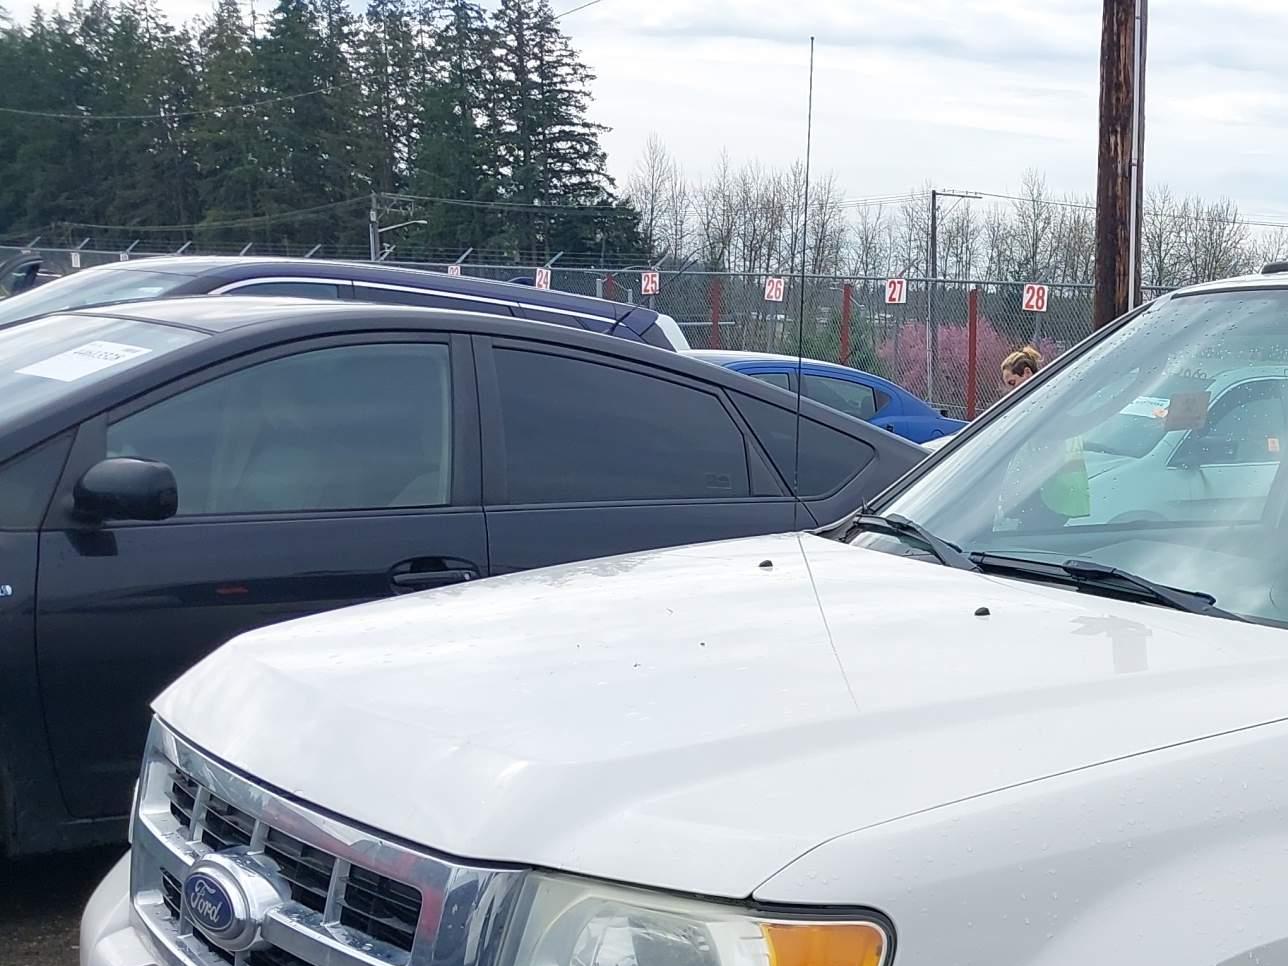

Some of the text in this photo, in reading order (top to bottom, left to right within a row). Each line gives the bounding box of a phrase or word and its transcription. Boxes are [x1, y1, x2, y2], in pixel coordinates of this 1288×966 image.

[537, 269, 549, 288] 24
[643, 273, 657, 293] 25
[766, 279, 782, 299] 26
[888, 281, 904, 301] 27
[1025, 286, 1046, 310] 28
[190, 879, 217, 923] Ford
